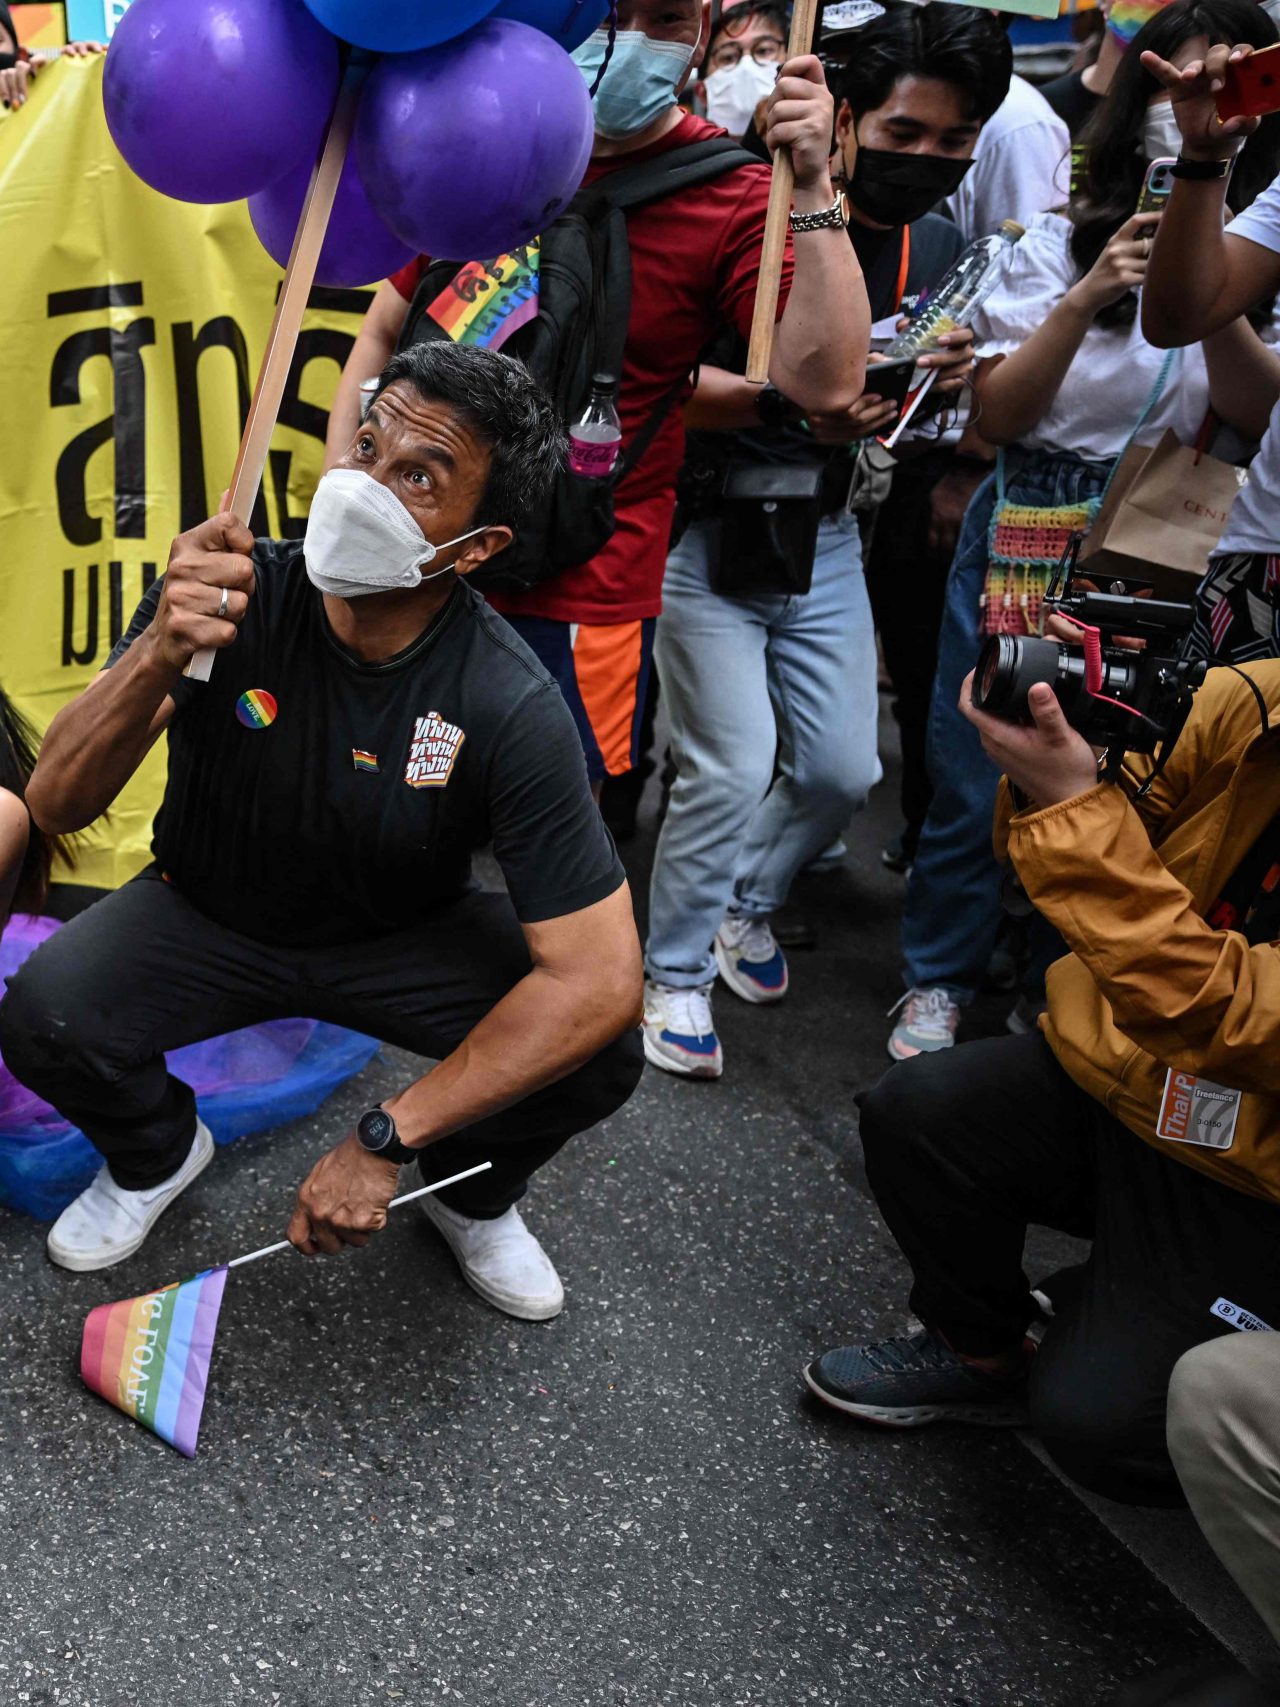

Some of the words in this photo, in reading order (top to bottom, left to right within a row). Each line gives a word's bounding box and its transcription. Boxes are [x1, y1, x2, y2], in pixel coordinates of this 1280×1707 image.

[413, 711, 462, 746] ทำงาน
[409, 738, 456, 760] ทำงาน
[405, 757, 451, 782] ทำงาน
[1164, 1092, 1191, 1136] Thai
